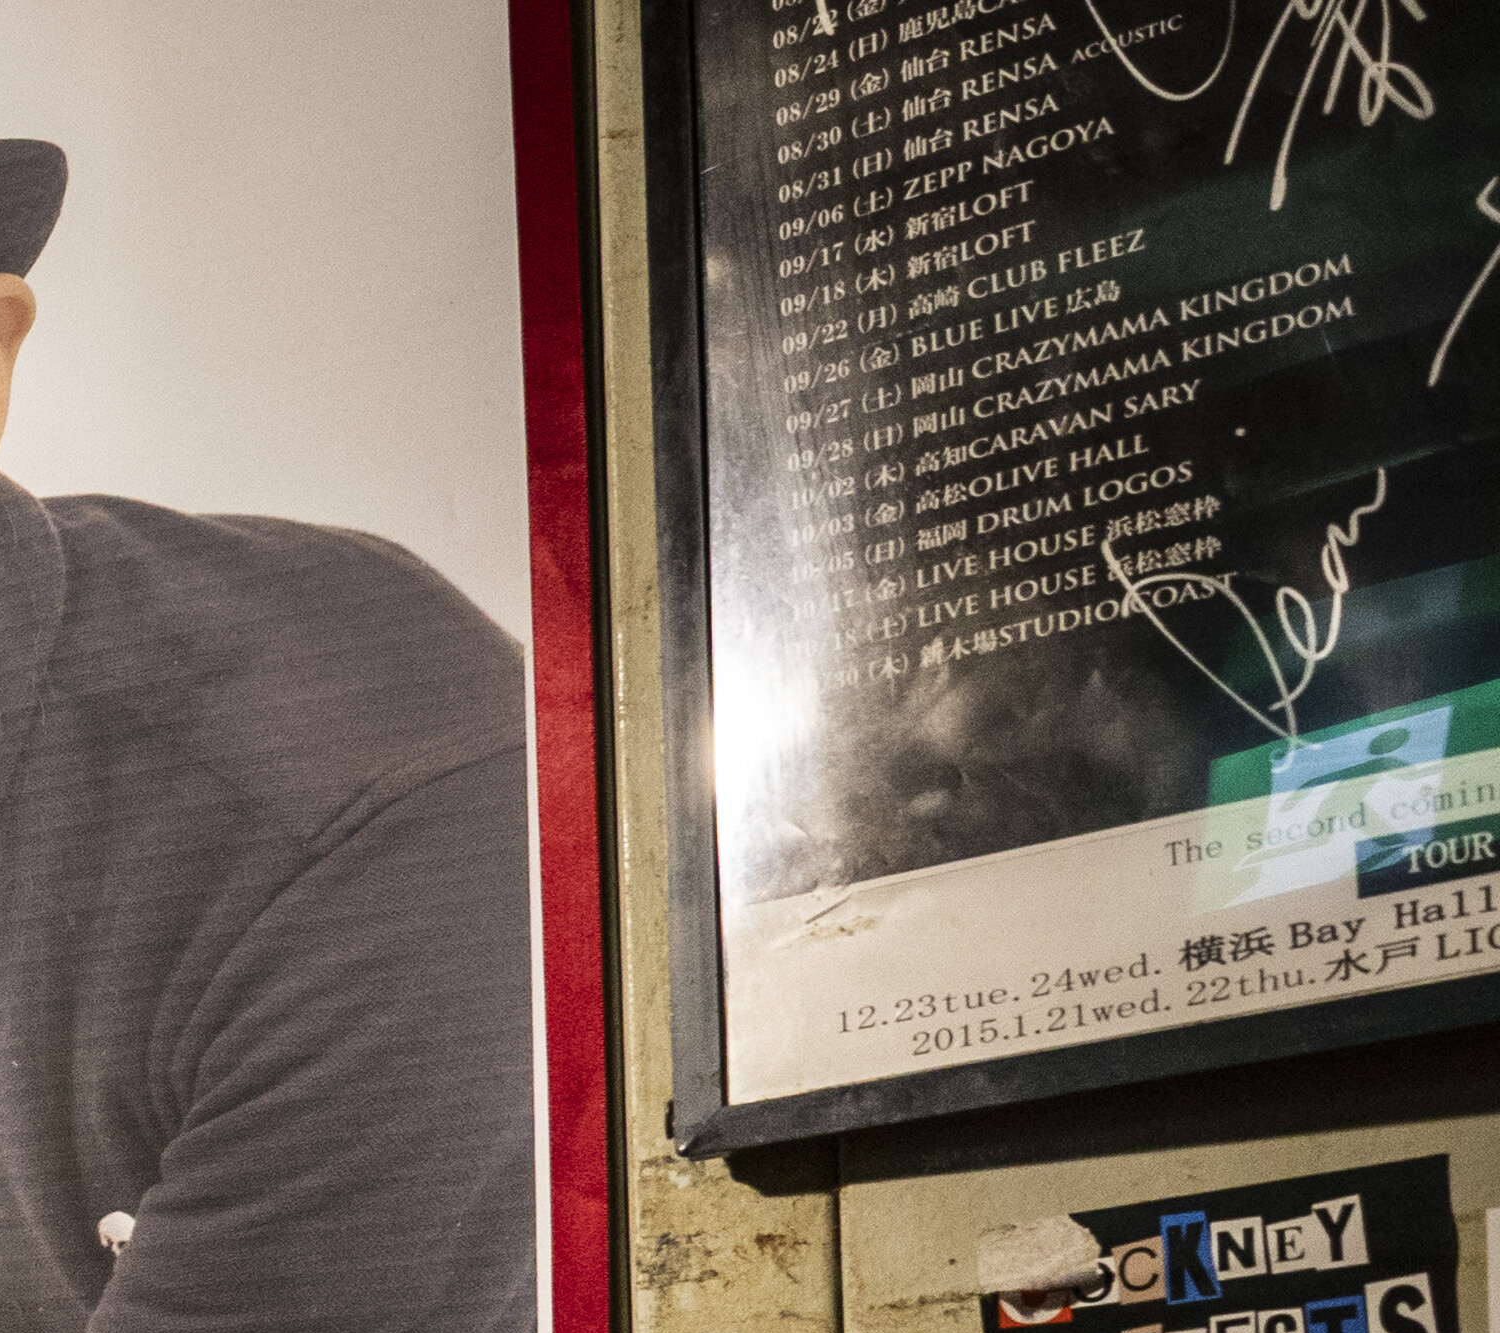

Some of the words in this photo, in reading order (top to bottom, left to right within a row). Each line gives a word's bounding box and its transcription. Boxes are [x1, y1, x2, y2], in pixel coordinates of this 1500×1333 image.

[776, 88, 841, 126] 08/29
[851, 68, 889, 101] (金)
[901, 49, 950, 83] 仙台
[959, 14, 1058, 61] RENSA
[778, 126, 842, 165] 08/30
[902, 88, 952, 123] 仙台
[961, 53, 1059, 101] RENSA
[1071, 14, 1184, 64] ACOUSTIC
[904, 161, 973, 201] ZEPP
[982, 117, 1116, 175] NAGOYA
[966, 258, 1047, 301] CLUB
[1057, 228, 1147, 274] FLEEZ
[911, 319, 984, 358] BLUE
[993, 297, 1059, 335] LIVE
[971, 307, 1170, 378] CRAZYMAMA
[1179, 254, 1354, 321] KINGDOM
[1165, 839, 1224, 867] The
[1403, 831, 1496, 873] TOUR
[1179, 926, 1275, 974] 横浜
[1289, 915, 1366, 951] Bay
[1394, 885, 1498, 929] Hall
[1324, 934, 1421, 984] 水戸
